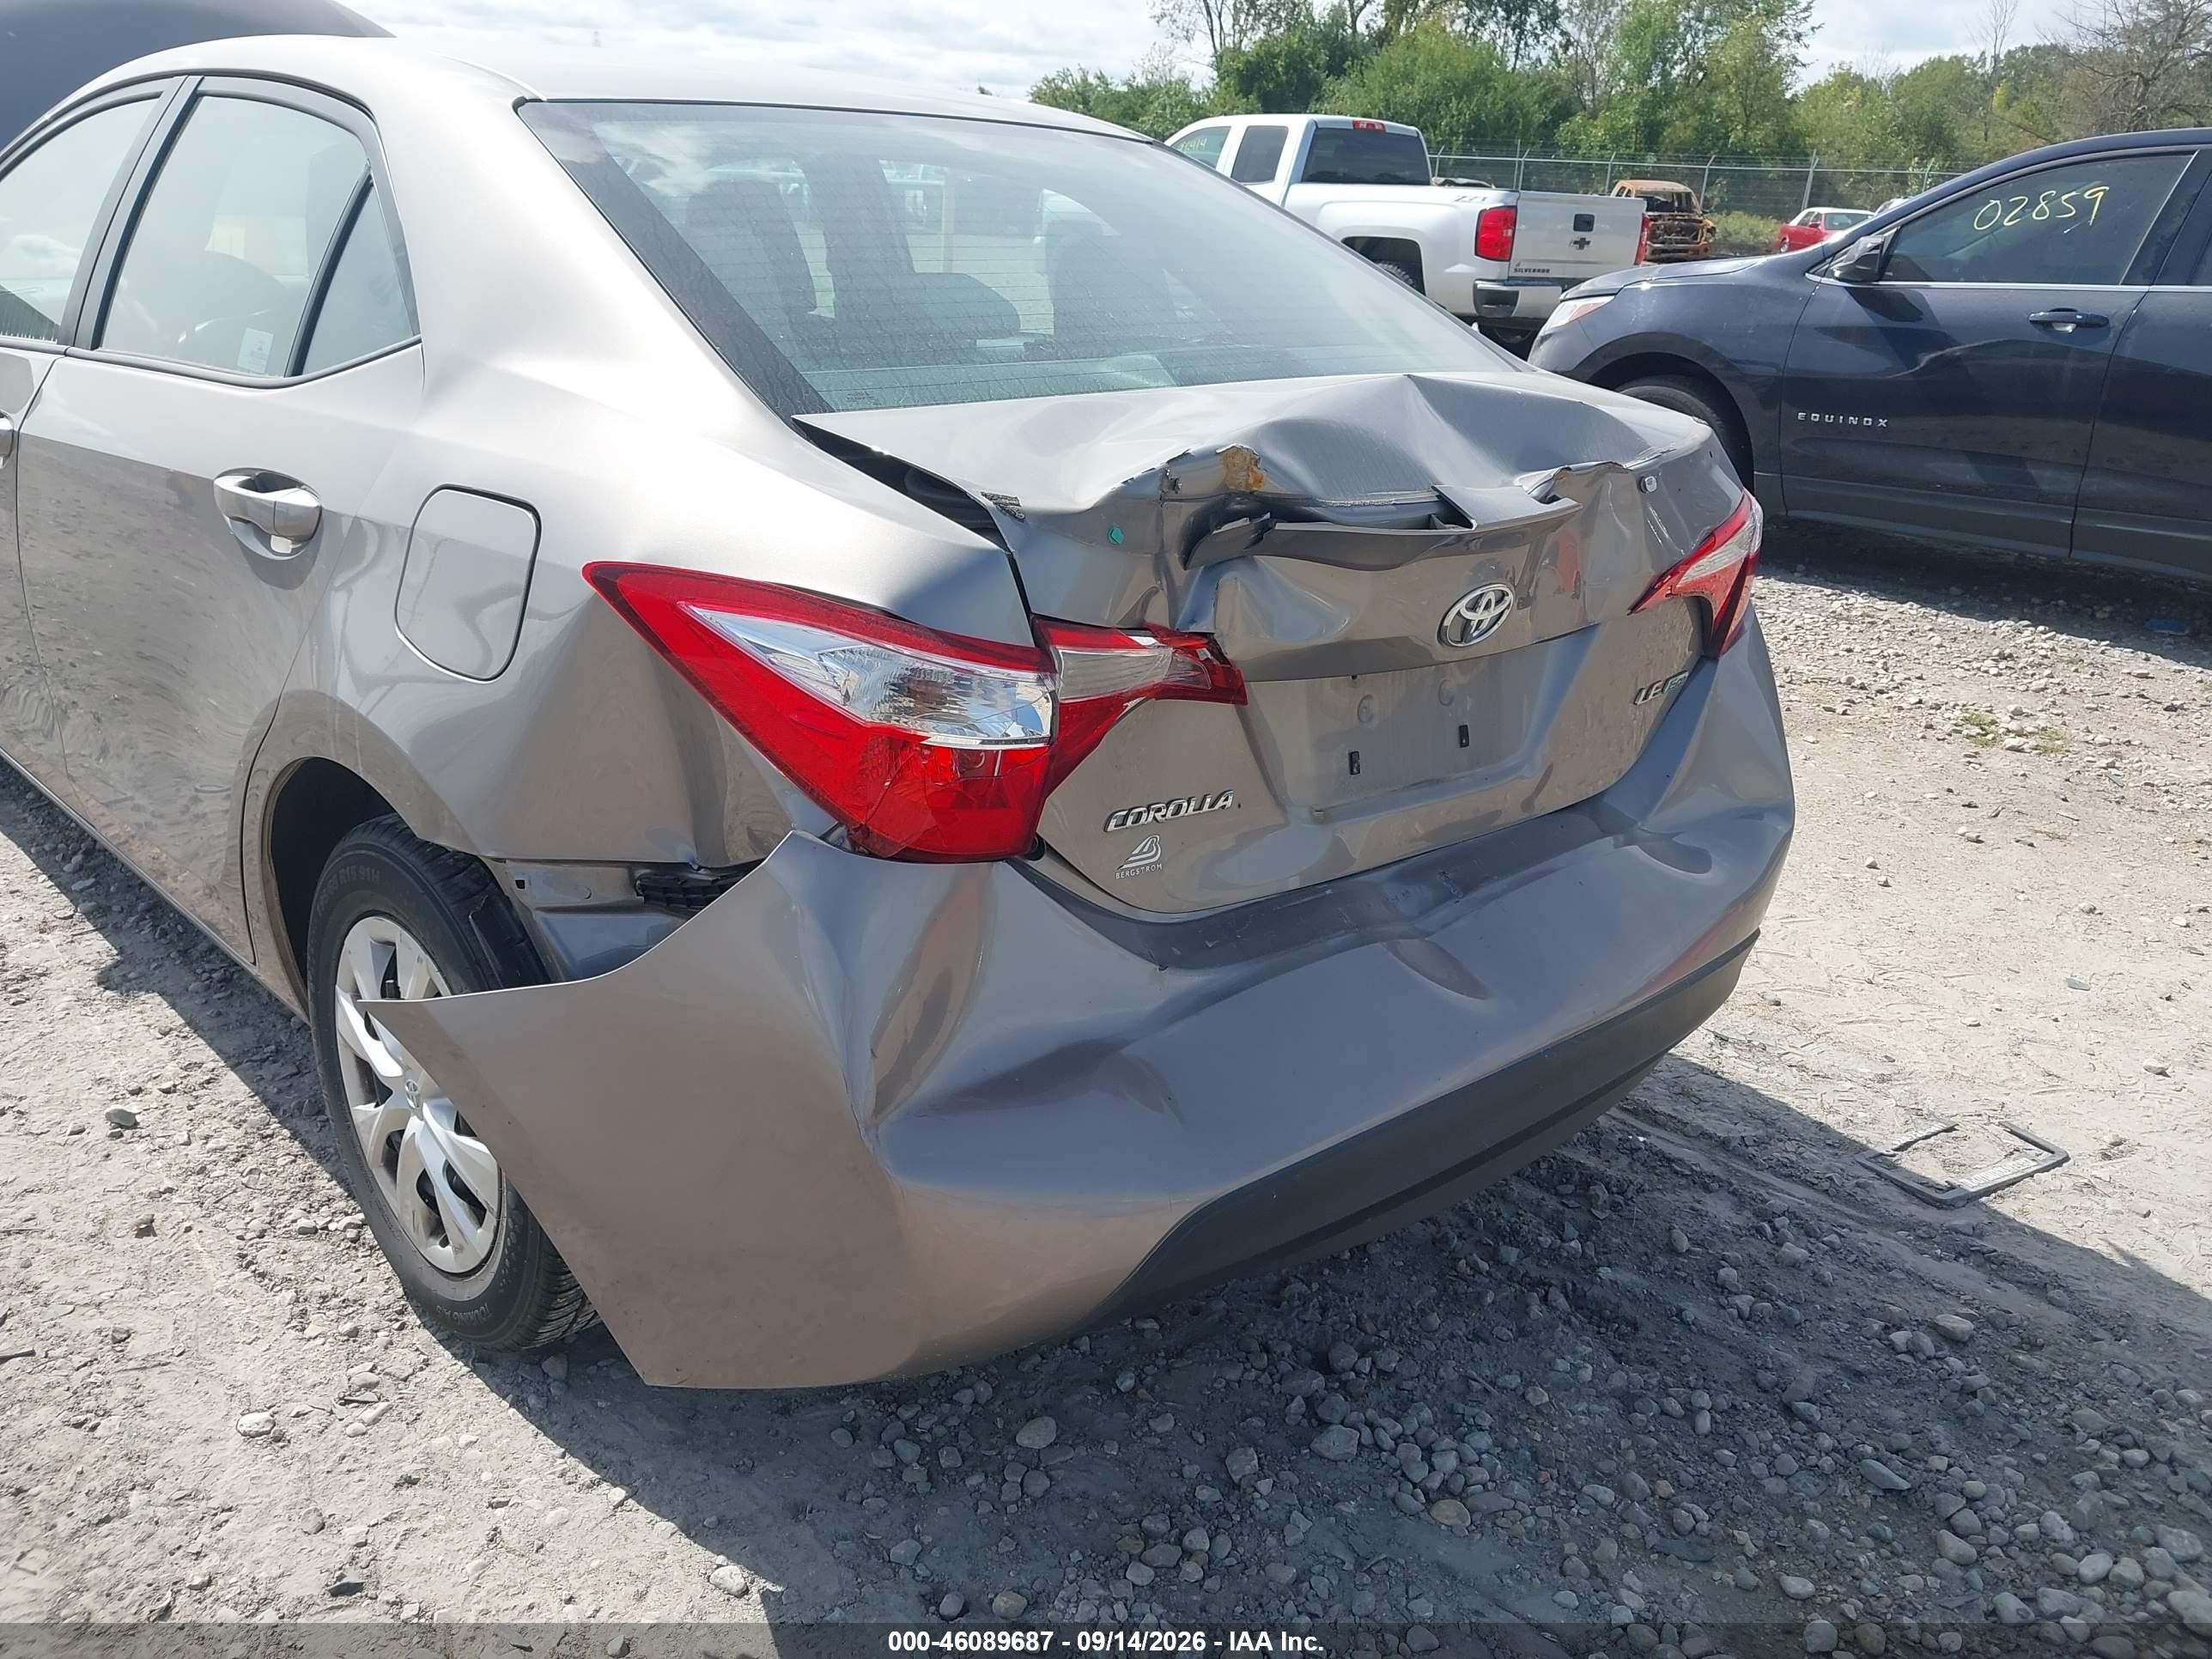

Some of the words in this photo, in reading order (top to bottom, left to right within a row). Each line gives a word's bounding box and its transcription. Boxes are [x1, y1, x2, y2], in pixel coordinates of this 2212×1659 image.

[1973, 185, 2111, 231] 02859
[1797, 411, 1888, 428] EQUINOX
[1103, 790, 1235, 832] COROLLA
[1115, 863, 1163, 879] BERGSTROM
